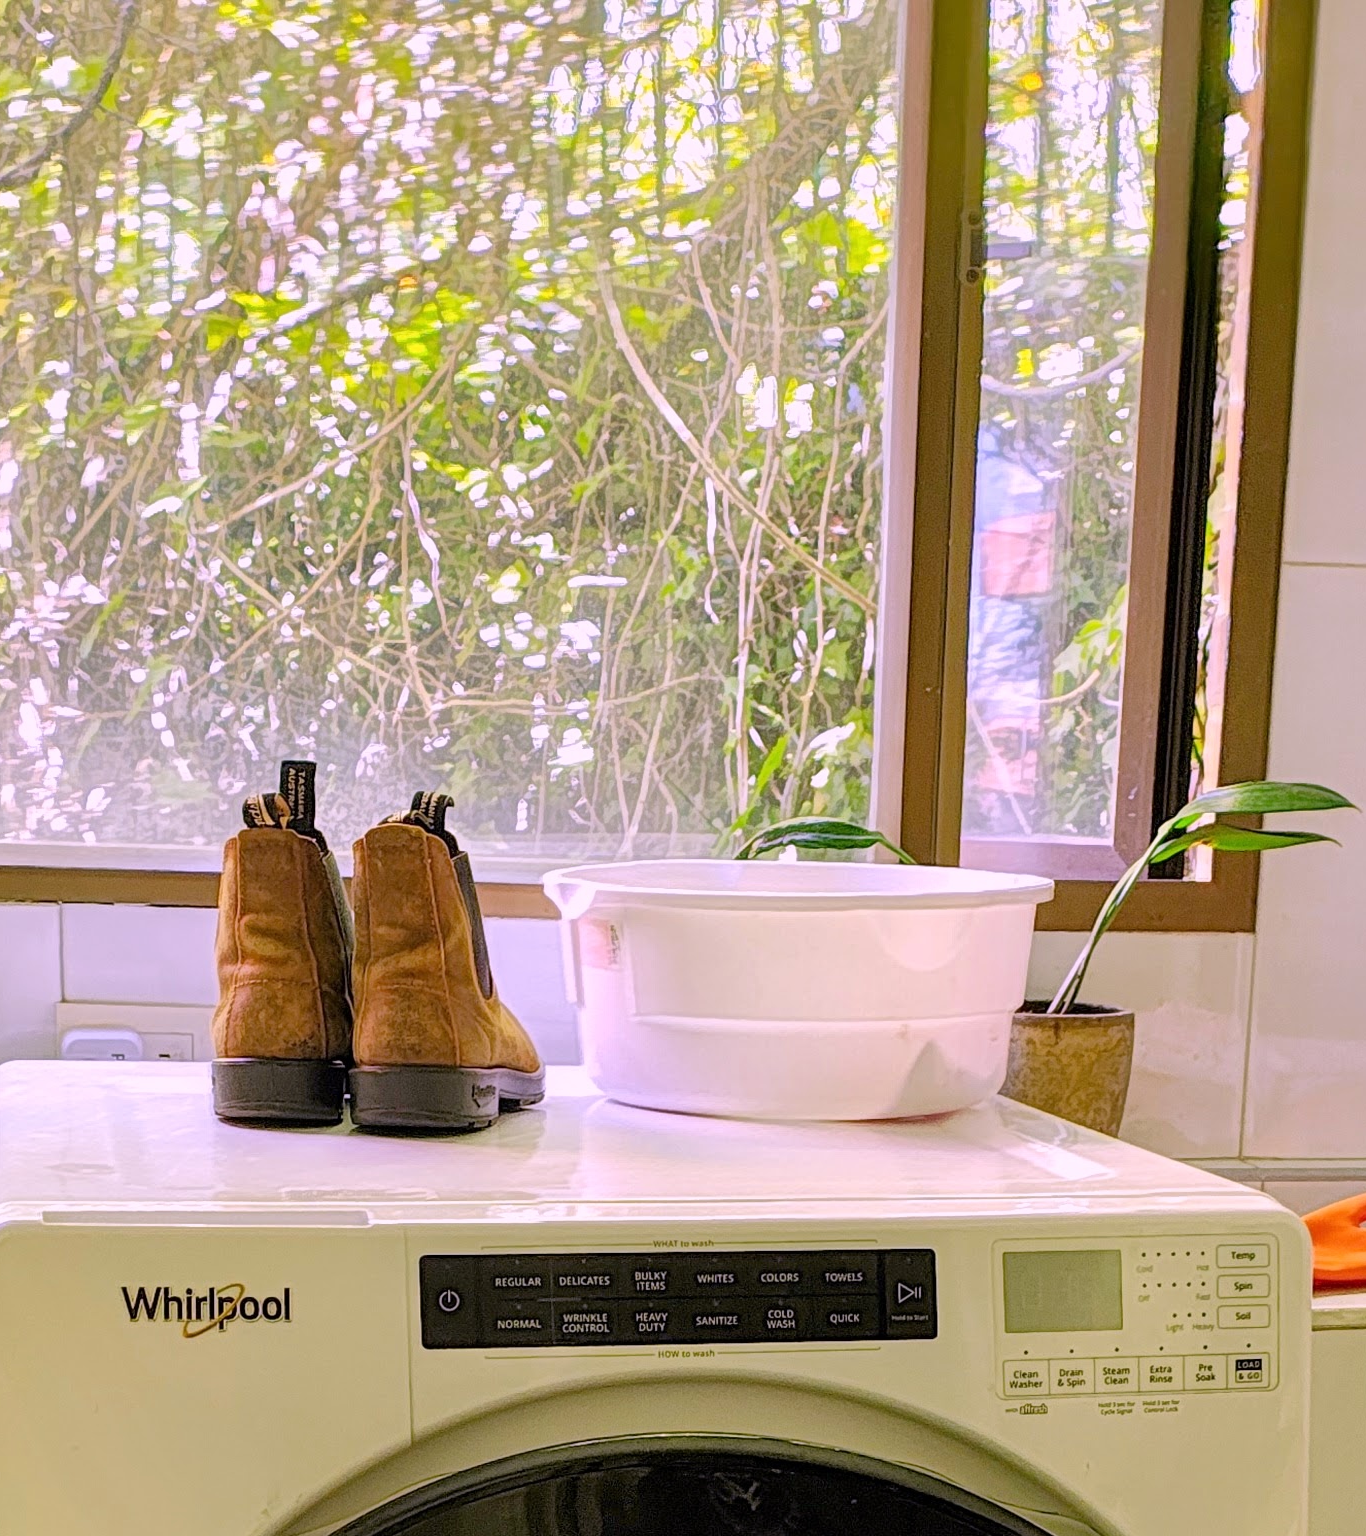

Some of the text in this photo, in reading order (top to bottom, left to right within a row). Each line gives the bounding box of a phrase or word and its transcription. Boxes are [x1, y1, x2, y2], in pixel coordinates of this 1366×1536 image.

[1231, 1251, 1256, 1261] Temp
[559, 1275, 611, 1287] DELICATES
[635, 1271, 668, 1281] BULKY
[697, 1273, 735, 1284] WHITES
[760, 1272, 799, 1283] COLORS
[825, 1272, 864, 1283] TOWELS
[495, 1276, 542, 1288] REGULAR
[636, 1281, 666, 1291] ITEMS
[1234, 1281, 1253, 1292] Spin
[121, 1286, 292, 1331] Whirlpool
[562, 1313, 608, 1323] WRINKLE
[635, 1312, 668, 1322] HEAVY
[767, 1309, 794, 1319] COLD
[829, 1313, 860, 1324] QUICK
[1235, 1311, 1251, 1320] Soil
[497, 1318, 542, 1329] NORMAL
[696, 1315, 739, 1326] SANITIZE
[766, 1319, 796, 1329] WASH
[562, 1323, 610, 1334] CONTROL
[638, 1322, 666, 1332] DUTY
[1149, 1365, 1172, 1374] Extra
[1198, 1363, 1213, 1372] Pre
[1237, 1360, 1260, 1369] LOAD
[1013, 1369, 1039, 1379] Clean
[1059, 1368, 1084, 1377] Drain
[1102, 1366, 1130, 1376] Steam
[1104, 1376, 1129, 1385] Clean
[1149, 1374, 1173, 1383] Rinse
[1195, 1373, 1216, 1382] Soak
[1009, 1380, 1043, 1389] Washer
[1066, 1378, 1086, 1388] Spin
